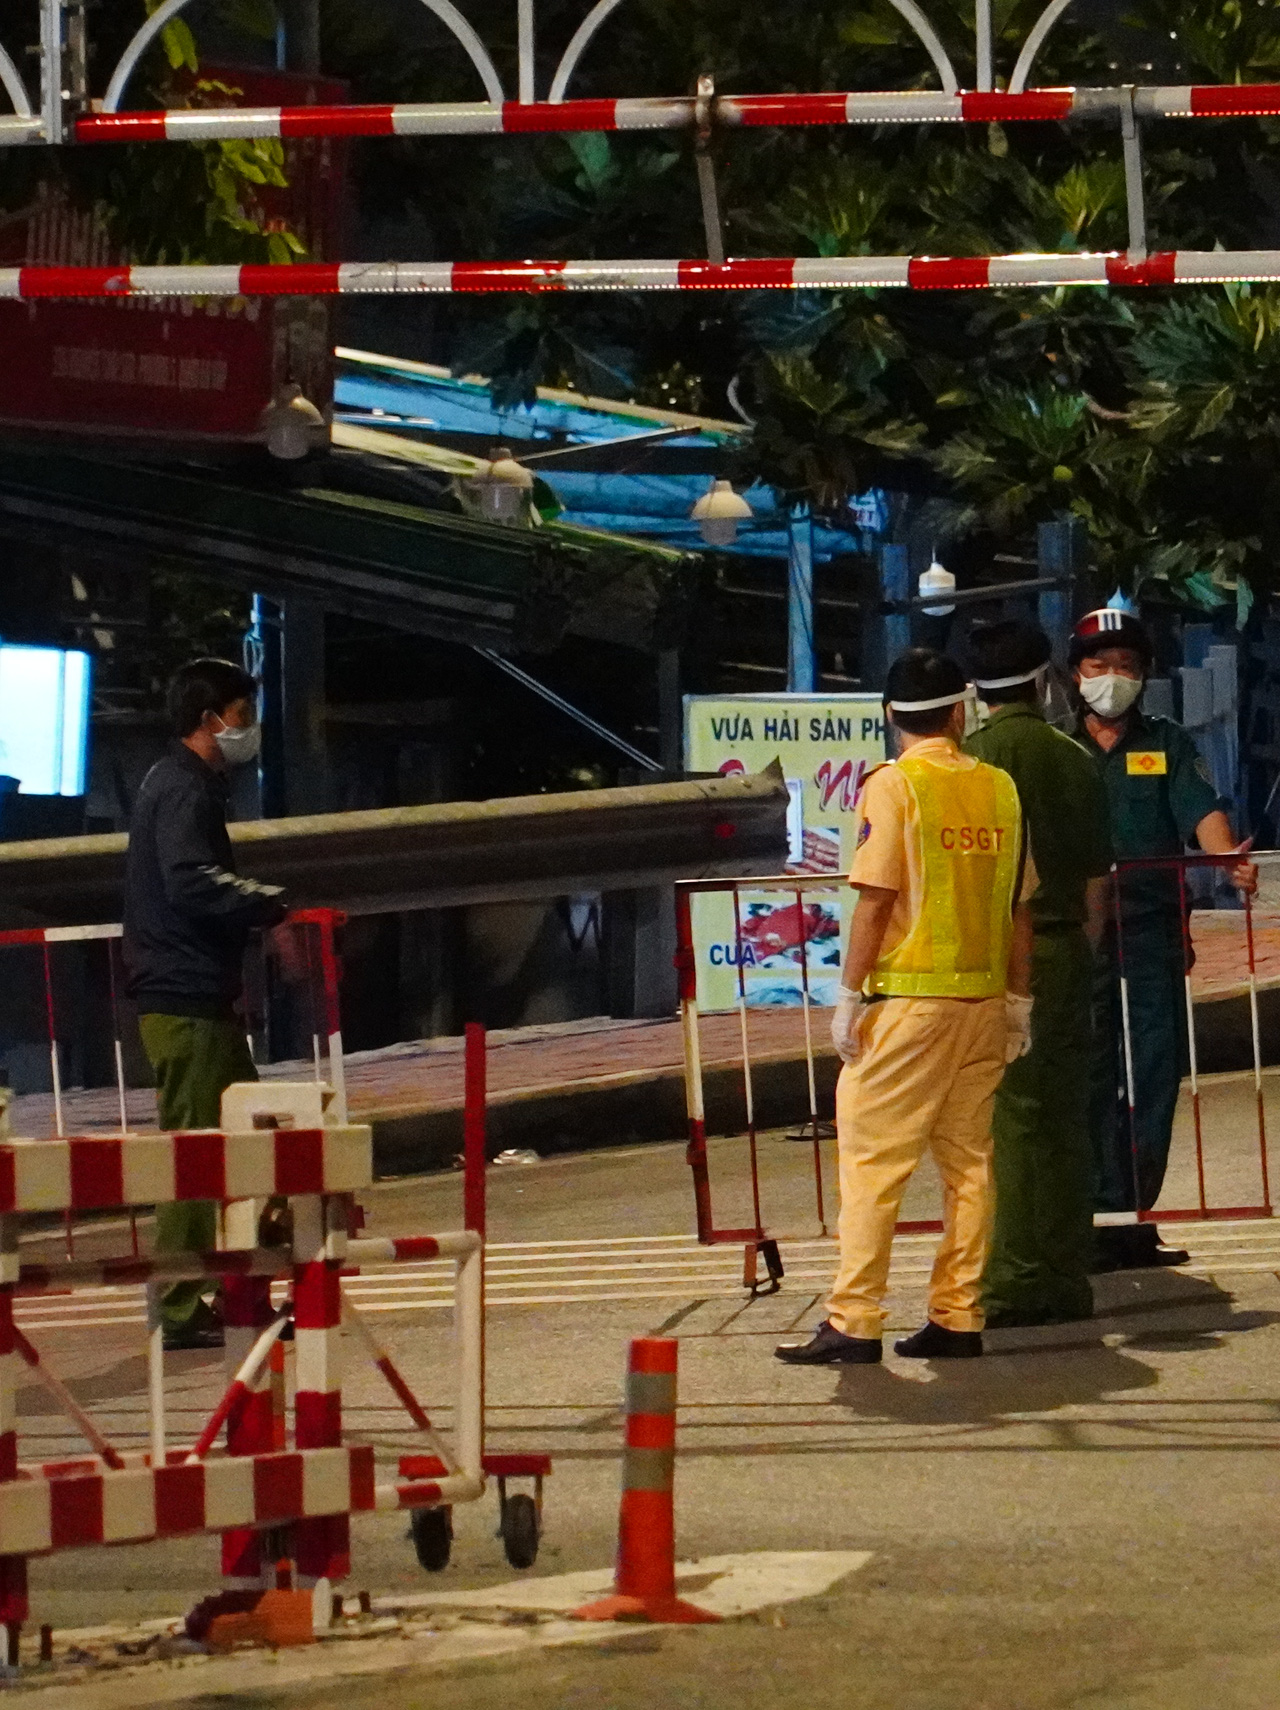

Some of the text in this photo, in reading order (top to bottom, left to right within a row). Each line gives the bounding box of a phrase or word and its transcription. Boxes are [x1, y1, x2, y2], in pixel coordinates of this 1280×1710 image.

[764, 710, 799, 741] HẢI
[809, 710, 851, 741] SẢN
[941, 827, 1004, 852] CSGT
[709, 943, 756, 966] CUA
